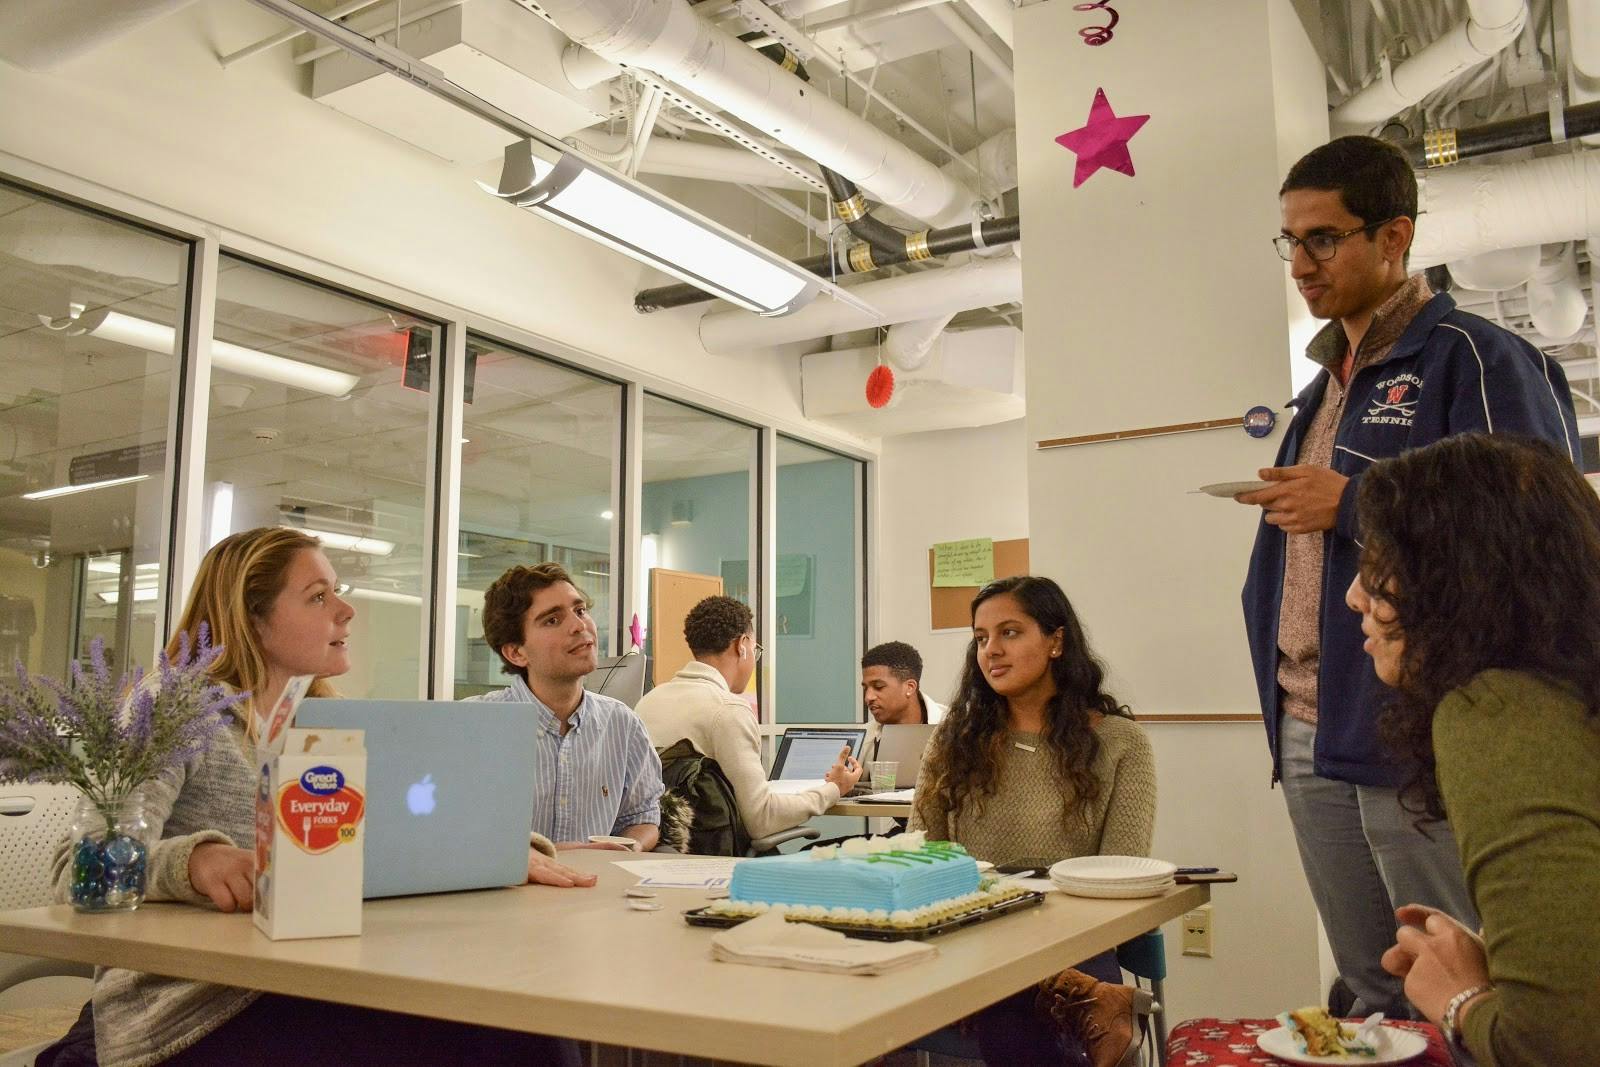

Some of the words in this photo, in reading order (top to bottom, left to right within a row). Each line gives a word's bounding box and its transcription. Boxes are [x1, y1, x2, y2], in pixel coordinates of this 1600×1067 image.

[1362, 416, 1413, 426] TENNIS
[304, 771, 338, 784] Great
[312, 780, 339, 790] Value
[290, 799, 350, 815] Everyday
[313, 815, 338, 824] FORKS
[340, 827, 356, 837] 100
